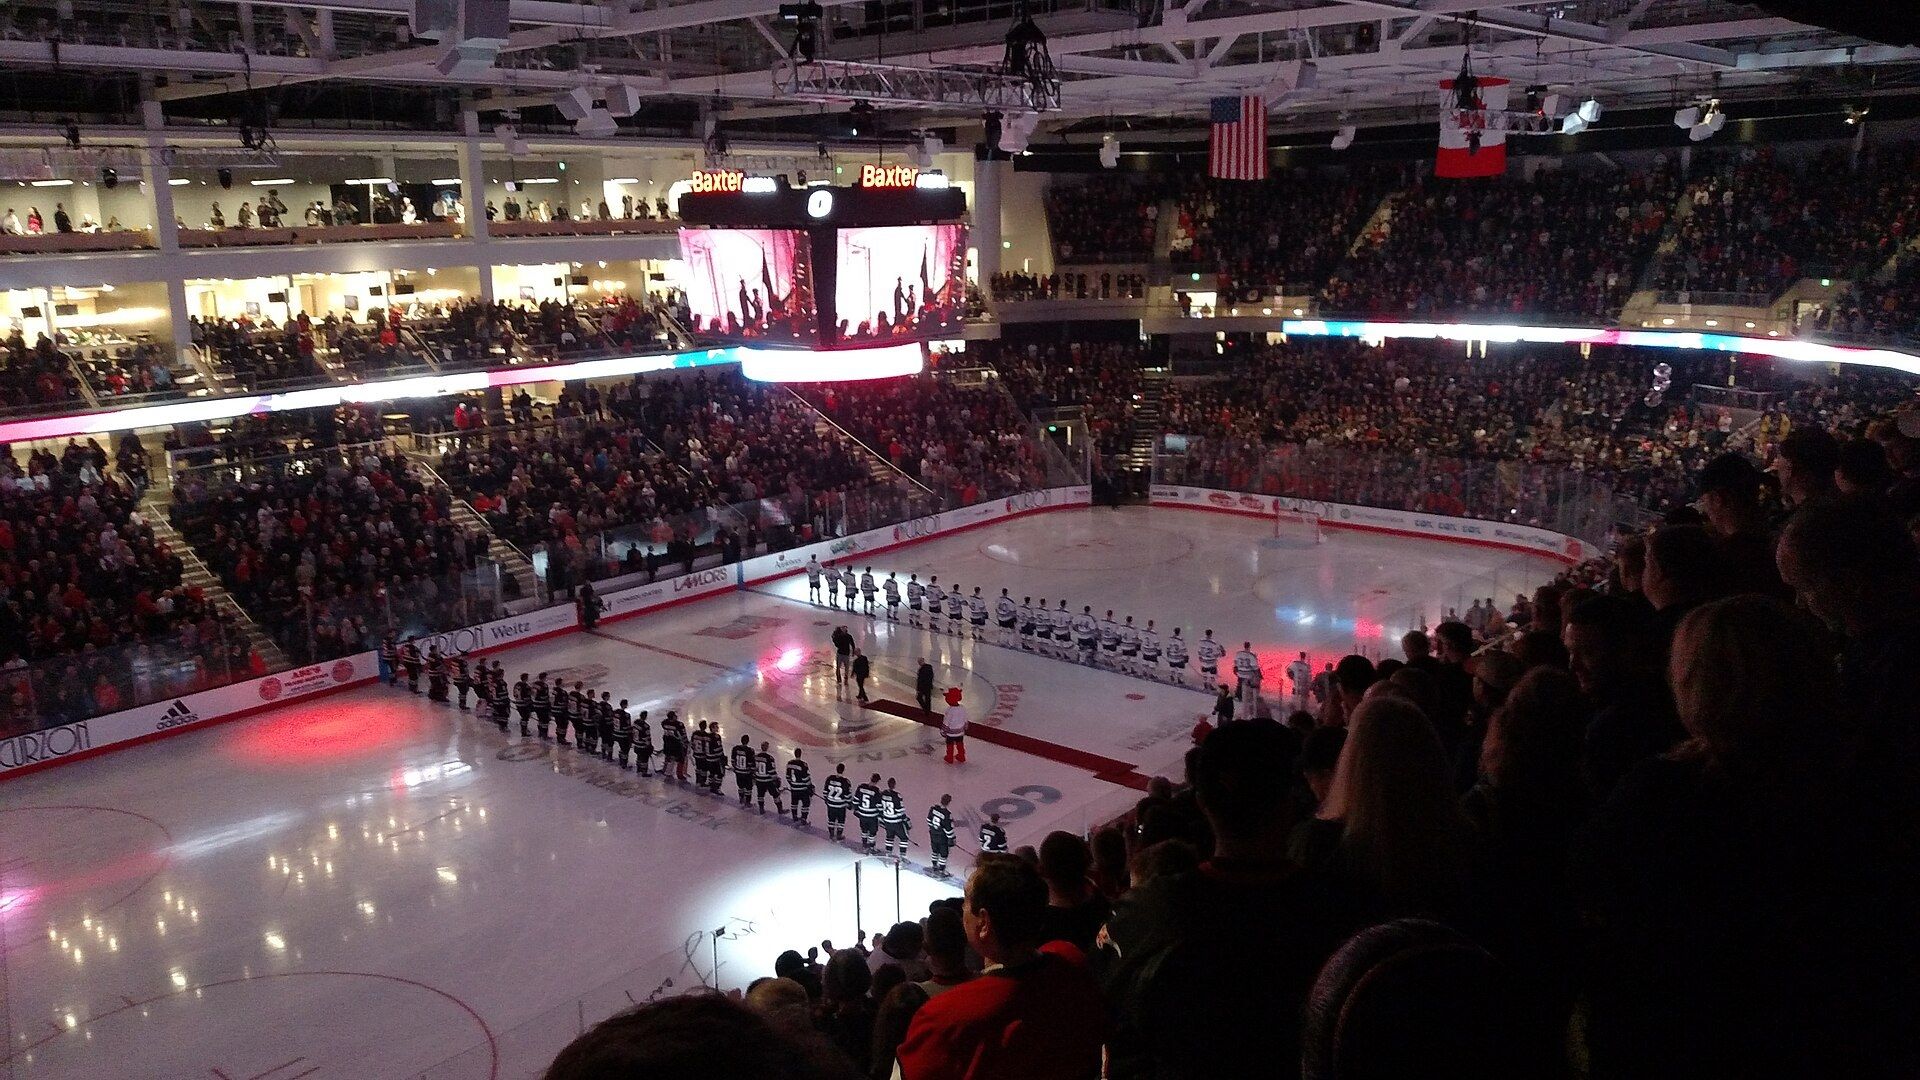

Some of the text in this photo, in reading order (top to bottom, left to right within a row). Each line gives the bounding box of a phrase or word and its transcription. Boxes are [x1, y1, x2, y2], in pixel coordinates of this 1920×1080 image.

[692, 169, 744, 192] Baxter
[862, 164, 918, 187] Baxter
[490, 621, 532, 640] Weitz
[156, 713, 199, 730] adidas
[0, 711, 91, 768] CURZON
[828, 785, 843, 800] 22
[861, 793, 871, 809] 5
[983, 834, 992, 850] 2
